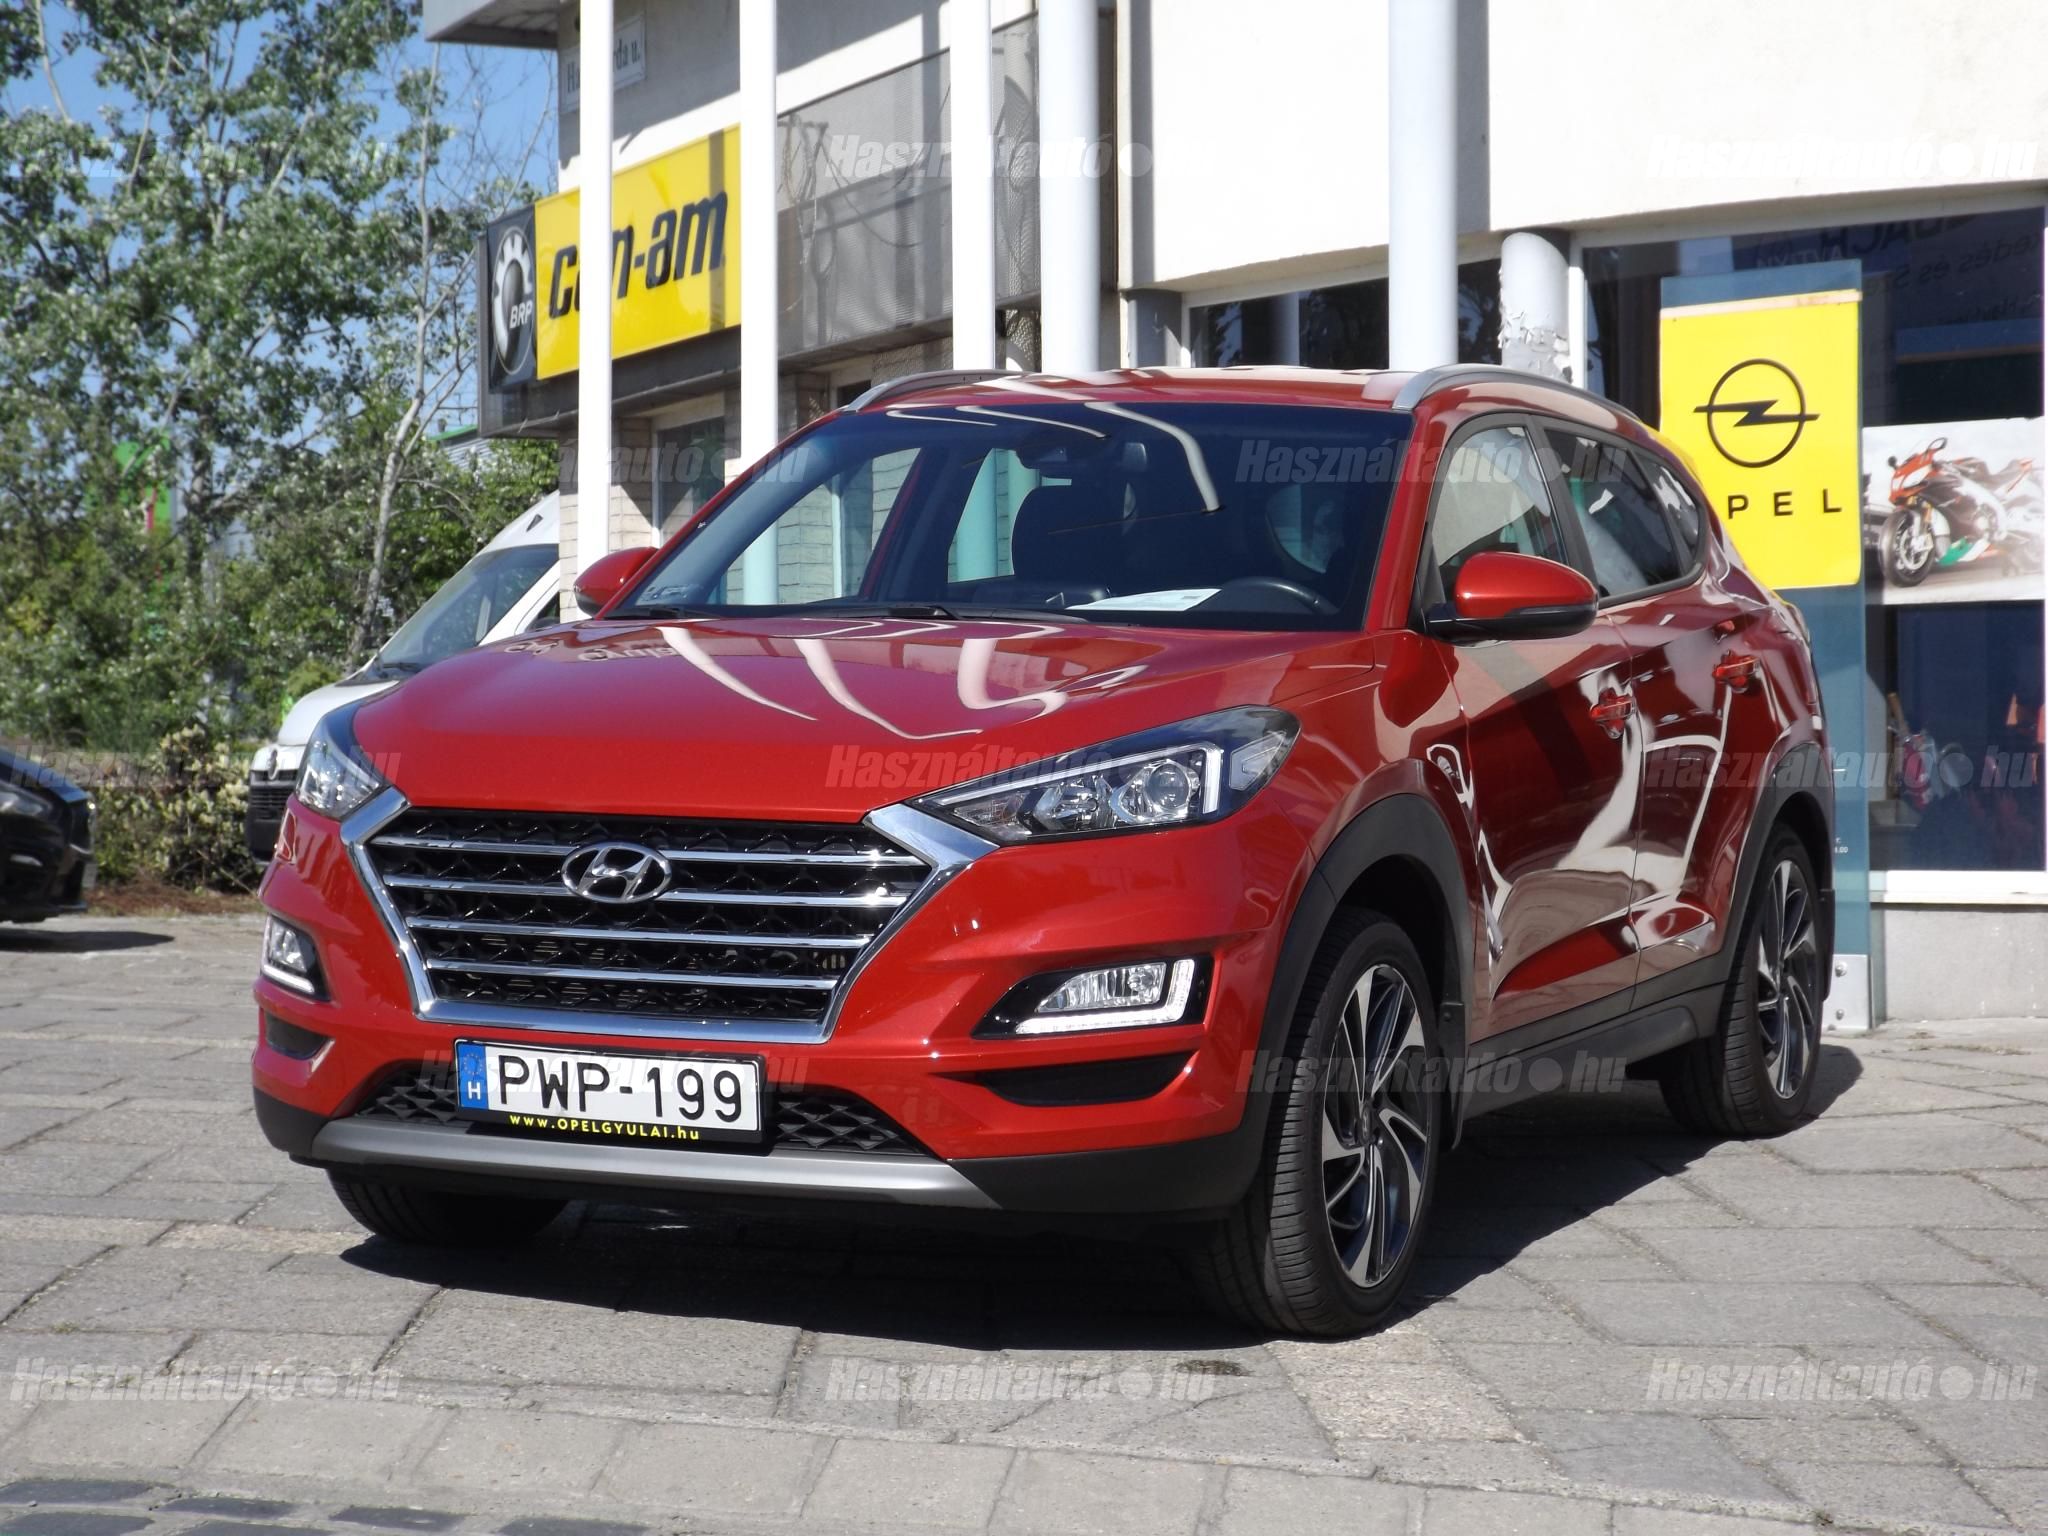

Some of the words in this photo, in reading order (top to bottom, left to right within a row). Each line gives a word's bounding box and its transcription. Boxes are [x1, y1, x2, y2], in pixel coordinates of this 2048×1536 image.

[548, 189, 729, 321] cn-am
[509, 299, 534, 329] BRP
[1727, 488, 1842, 520] PEL
[467, 1081, 481, 1100] H
[498, 1054, 742, 1123] PWP-199
[509, 1114, 700, 1140] www.OPELGYULAI.hu
